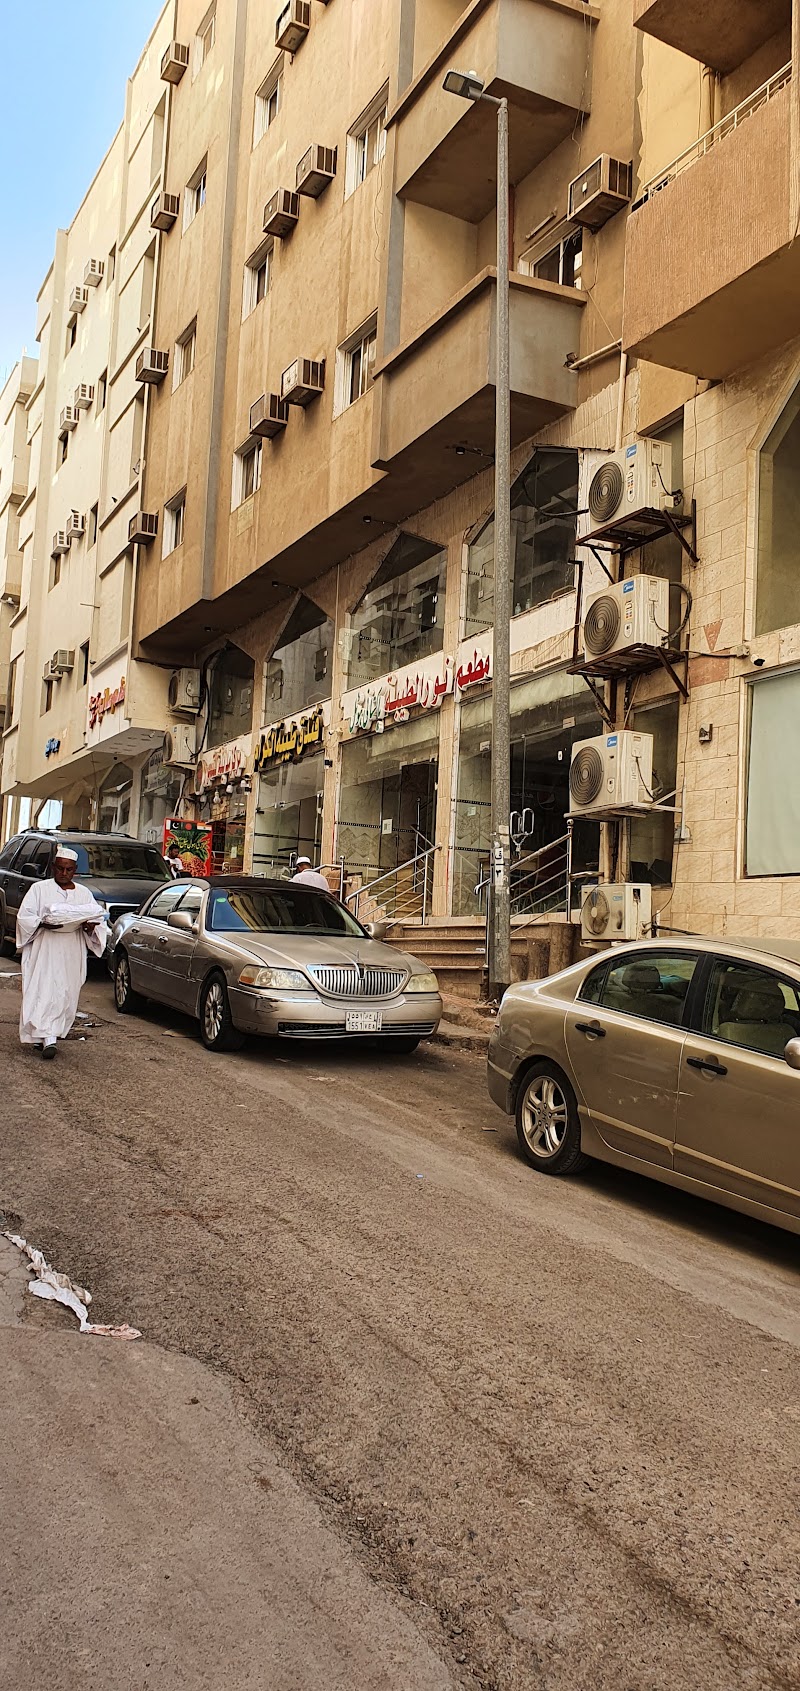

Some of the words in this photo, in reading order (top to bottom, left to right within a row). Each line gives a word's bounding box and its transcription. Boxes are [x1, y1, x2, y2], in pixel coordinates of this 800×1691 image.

[421, 657, 454, 707] نور
[456, 647, 490, 688] مطعم
[385, 672, 424, 721] الطيبة
[296, 704, 323, 755] فندق
[348, 1022, 362, 1030] 1551
